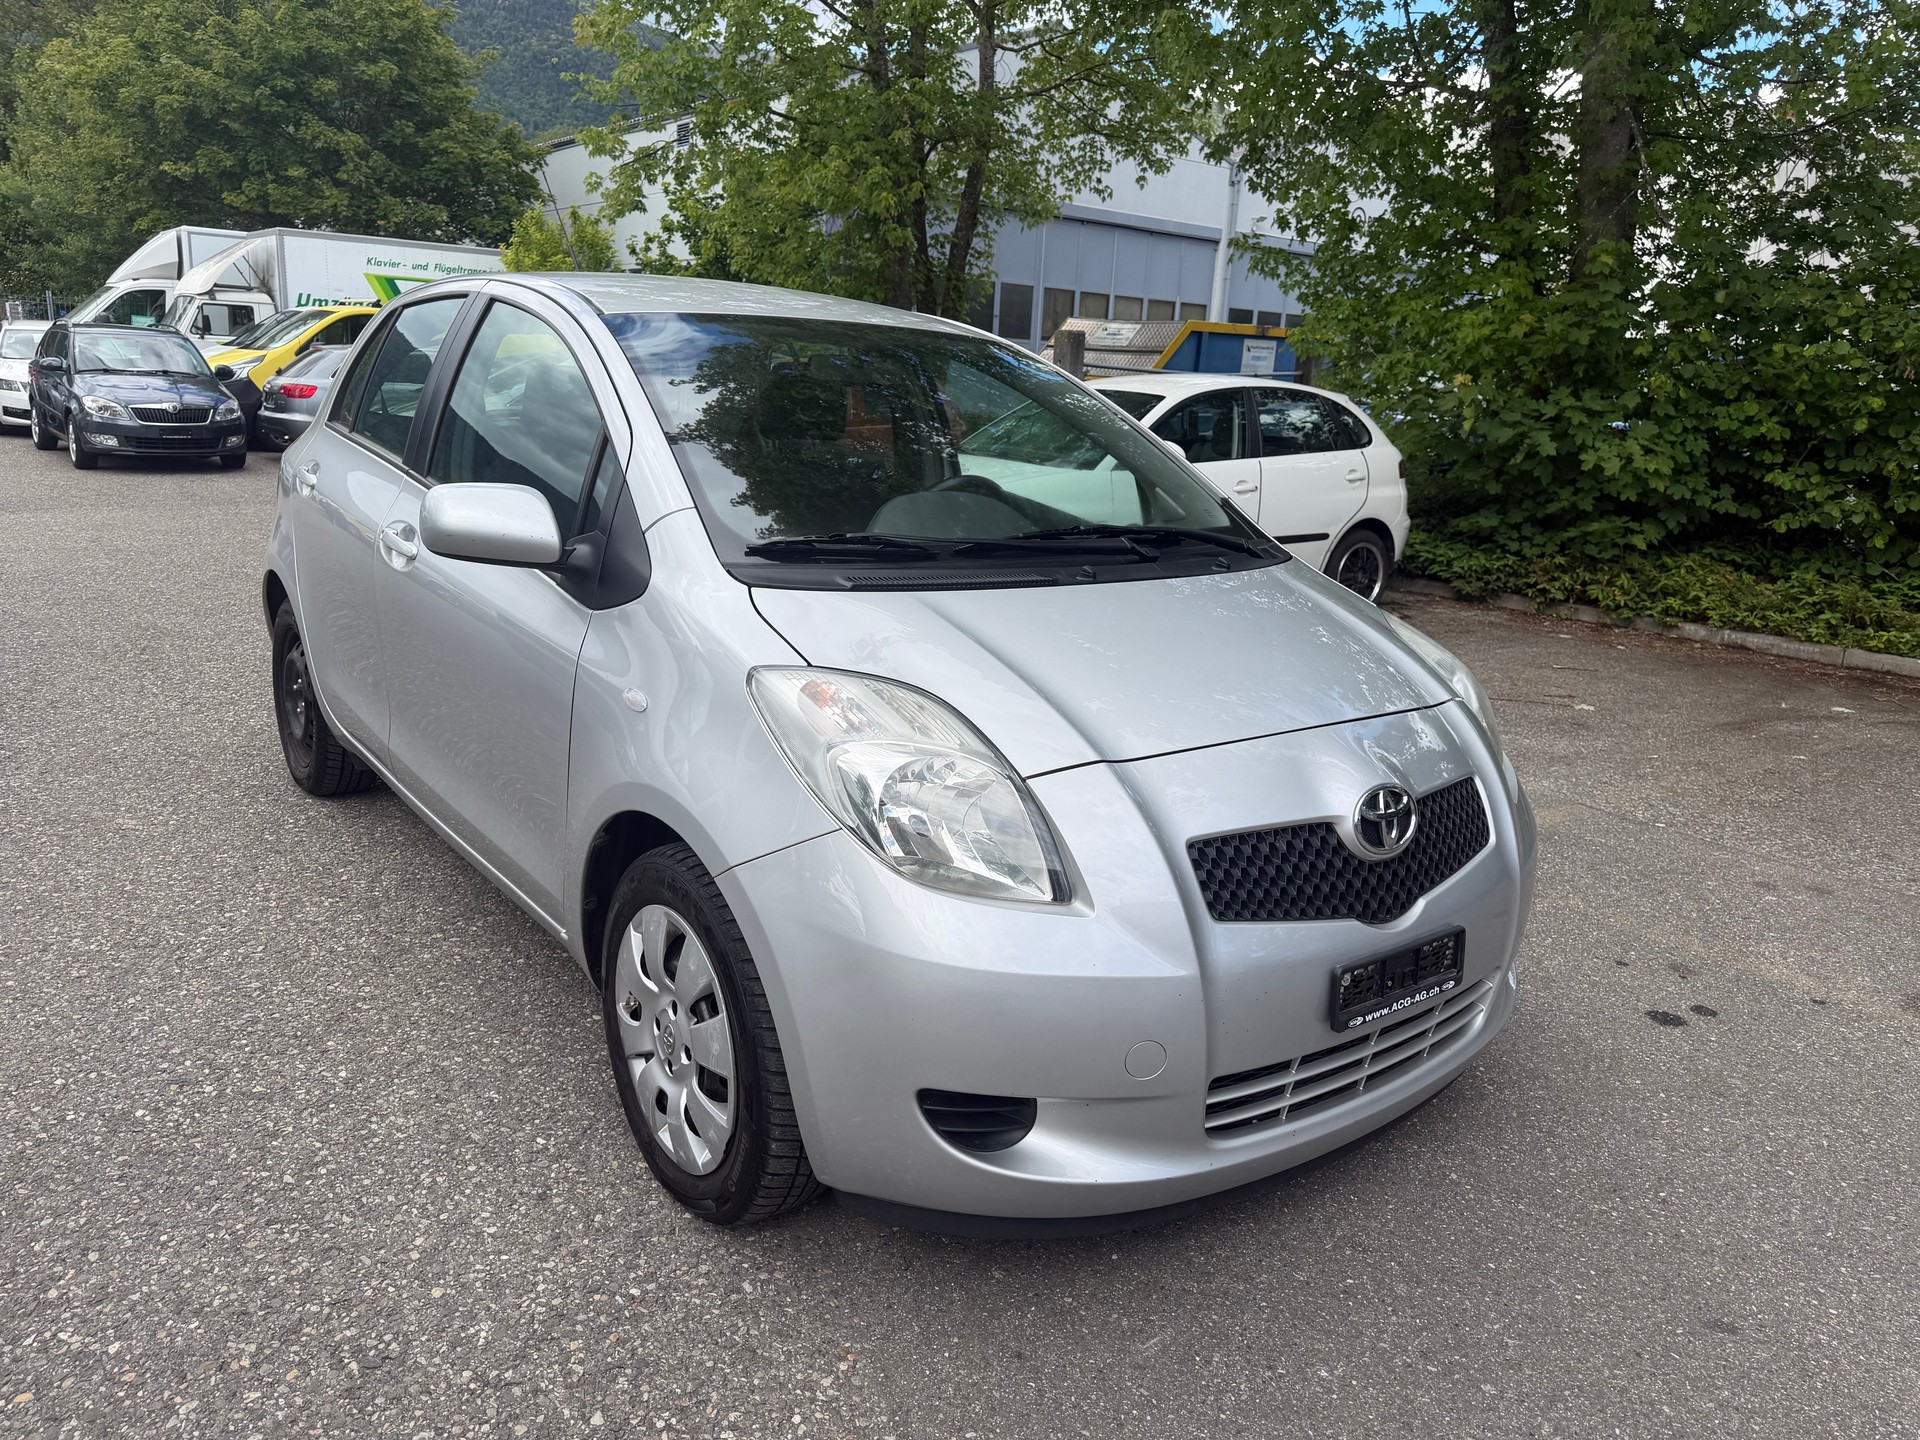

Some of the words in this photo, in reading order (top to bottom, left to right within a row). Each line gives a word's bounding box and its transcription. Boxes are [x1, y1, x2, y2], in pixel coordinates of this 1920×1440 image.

[366, 257, 407, 269] Klavier-
[411, 262, 429, 271] und
[1365, 986, 1440, 1022] www.ACG-AG.ch
